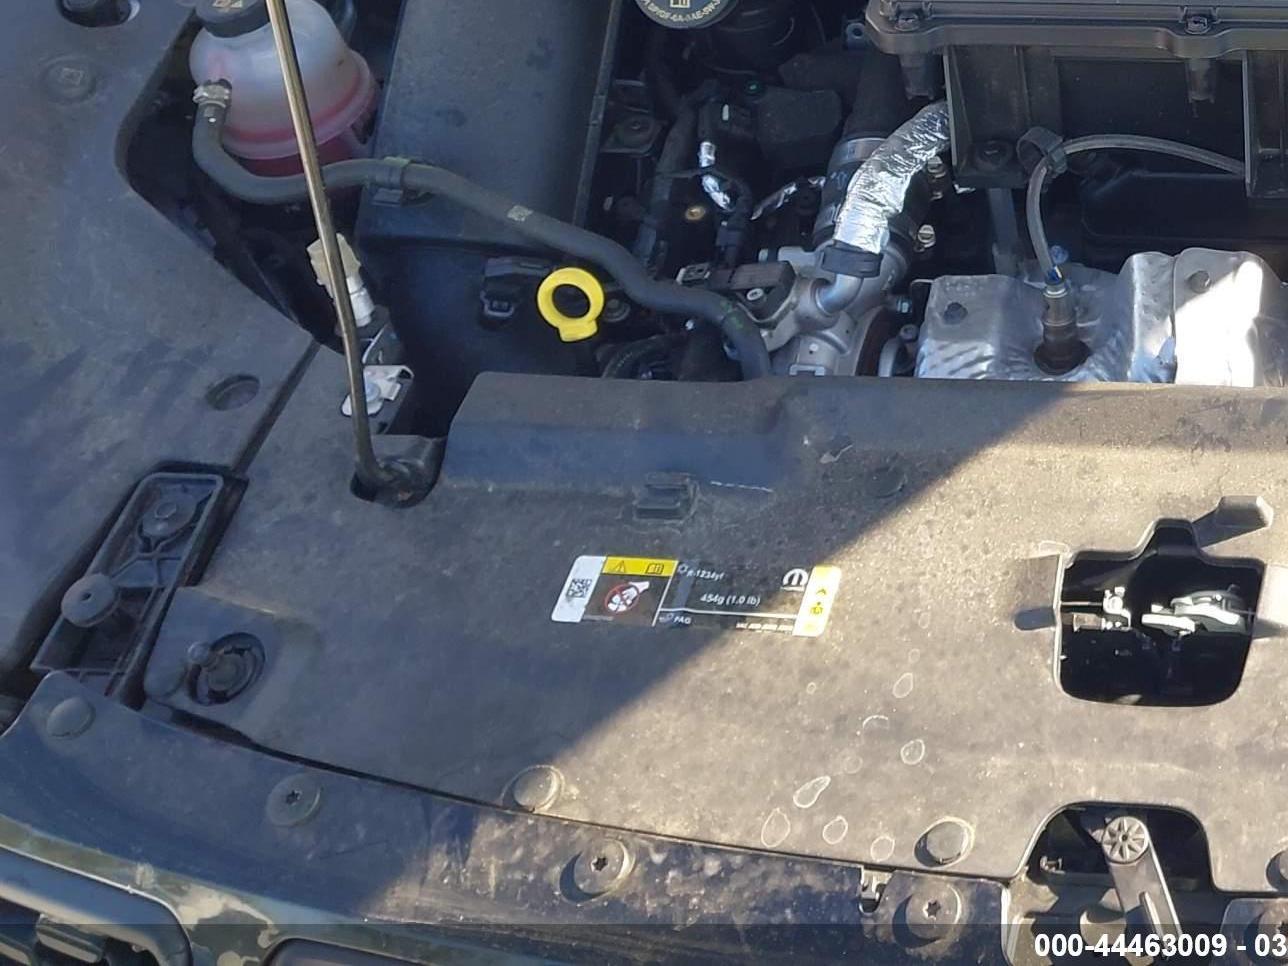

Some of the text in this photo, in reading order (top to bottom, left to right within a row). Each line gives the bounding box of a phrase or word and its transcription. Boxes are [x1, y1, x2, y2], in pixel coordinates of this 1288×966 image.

[700, 593, 761, 607] 454g (1.0 lb)
